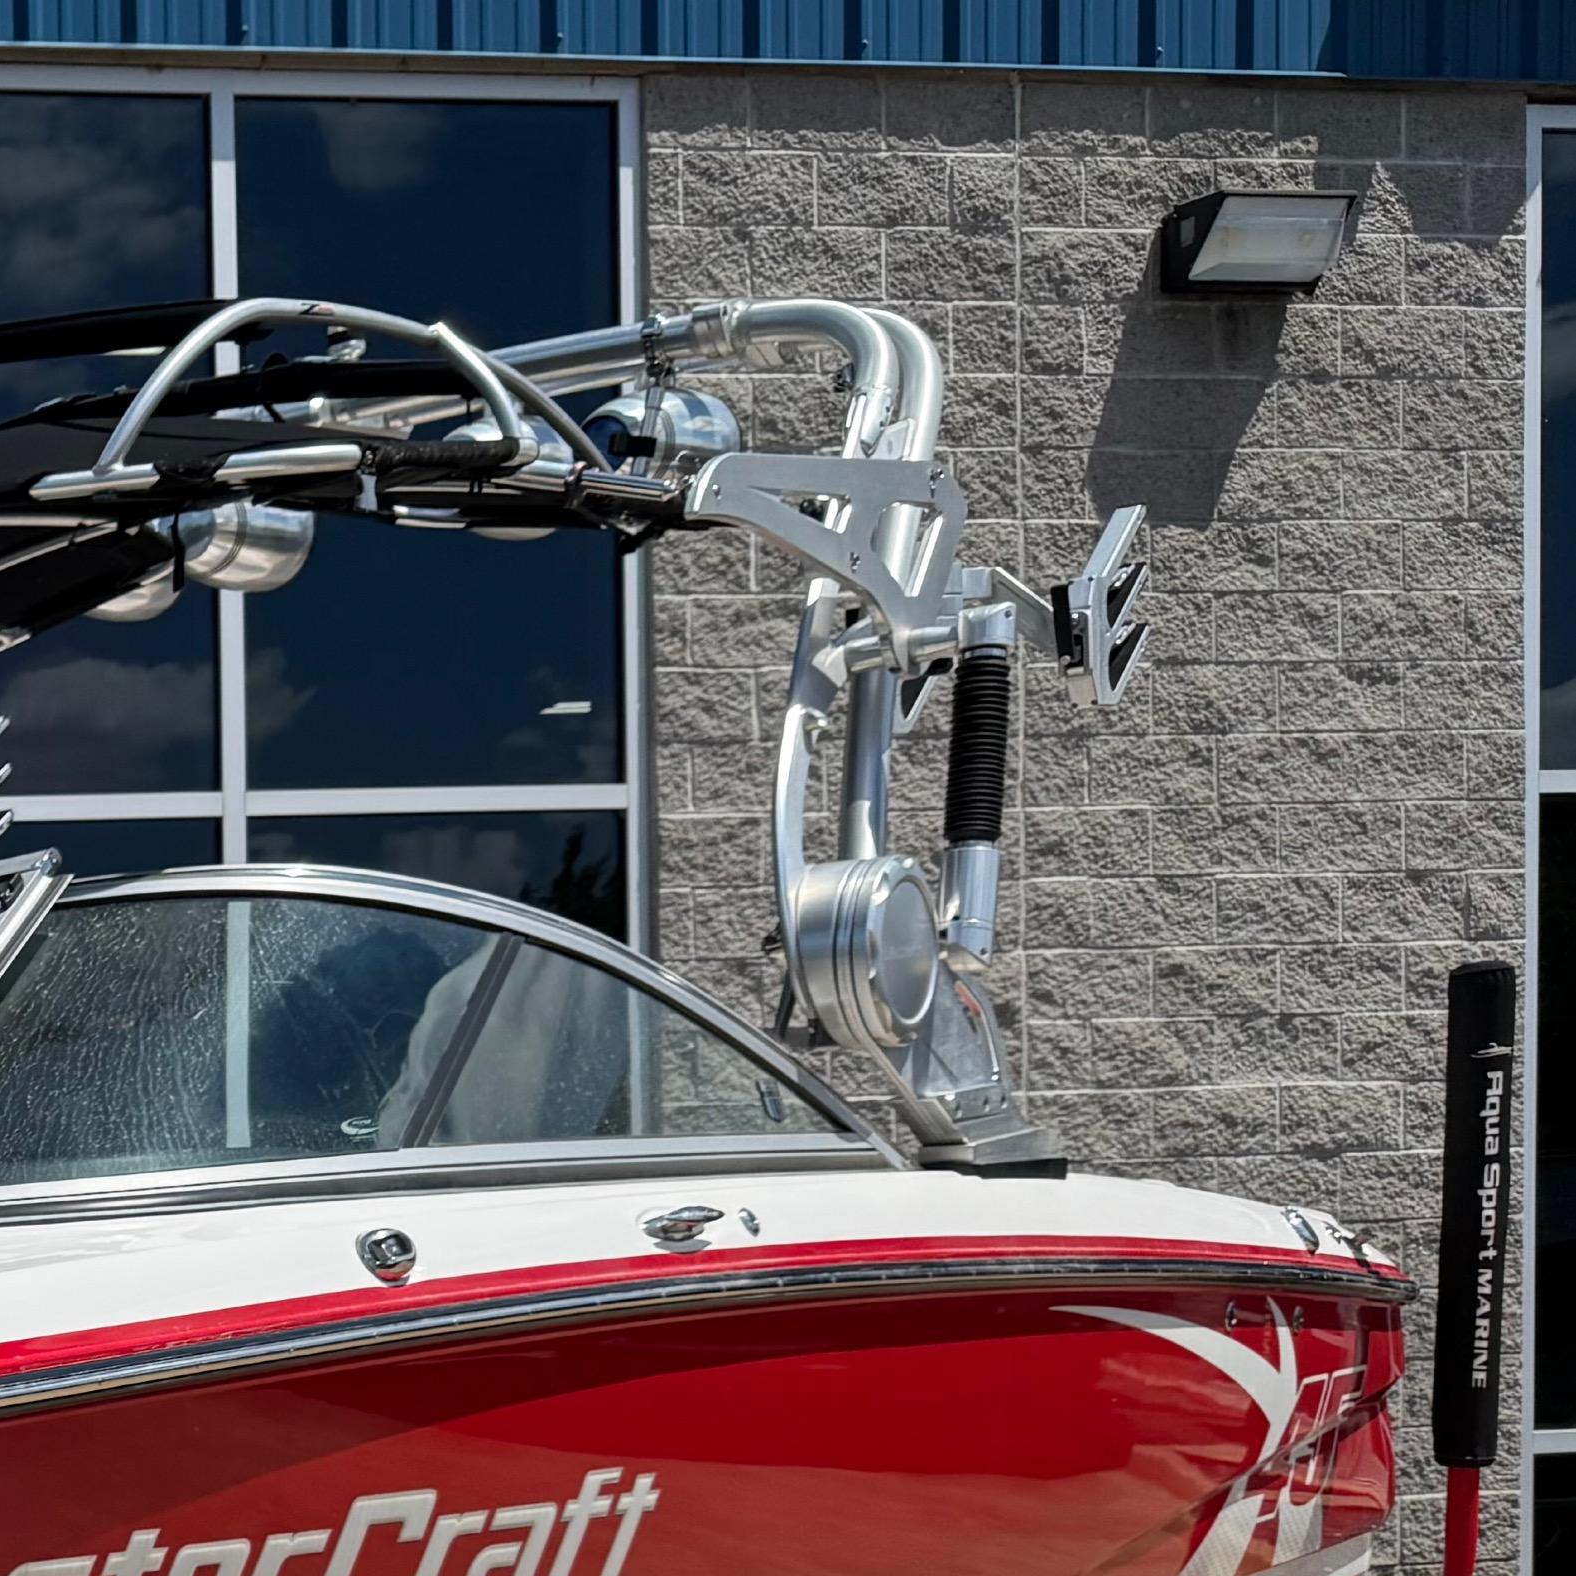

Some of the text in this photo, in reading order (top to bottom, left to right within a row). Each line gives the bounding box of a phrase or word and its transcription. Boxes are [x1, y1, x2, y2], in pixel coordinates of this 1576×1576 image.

[1471, 1070, 1504, 1388] Aqua Sport MARINE
